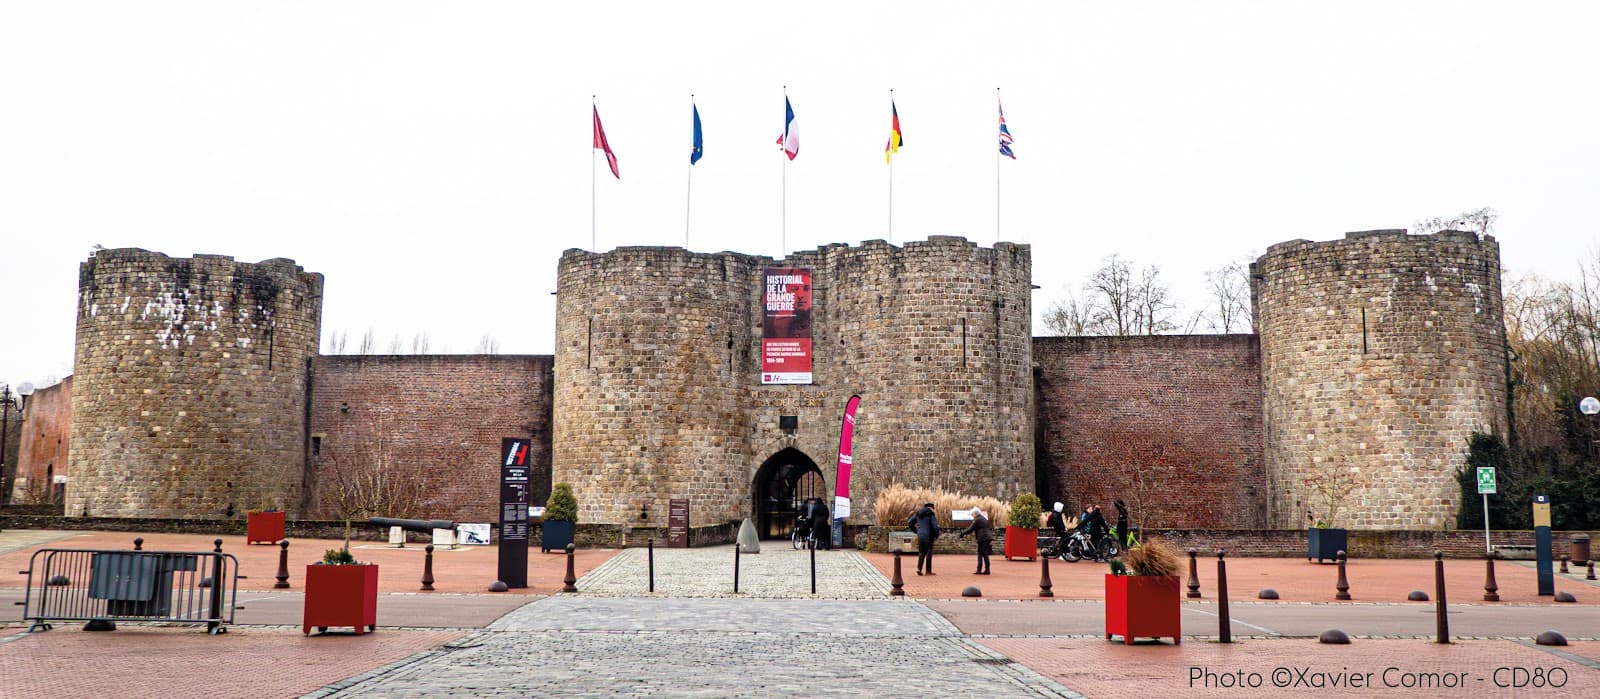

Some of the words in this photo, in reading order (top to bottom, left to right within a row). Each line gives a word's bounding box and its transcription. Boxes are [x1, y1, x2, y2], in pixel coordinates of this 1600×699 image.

[767, 275, 804, 284] HISTORIAL
[767, 284, 776, 293] DE
[778, 284, 786, 293] LA
[767, 292, 795, 301] GRANDE
[767, 301, 795, 311] GUERRE
